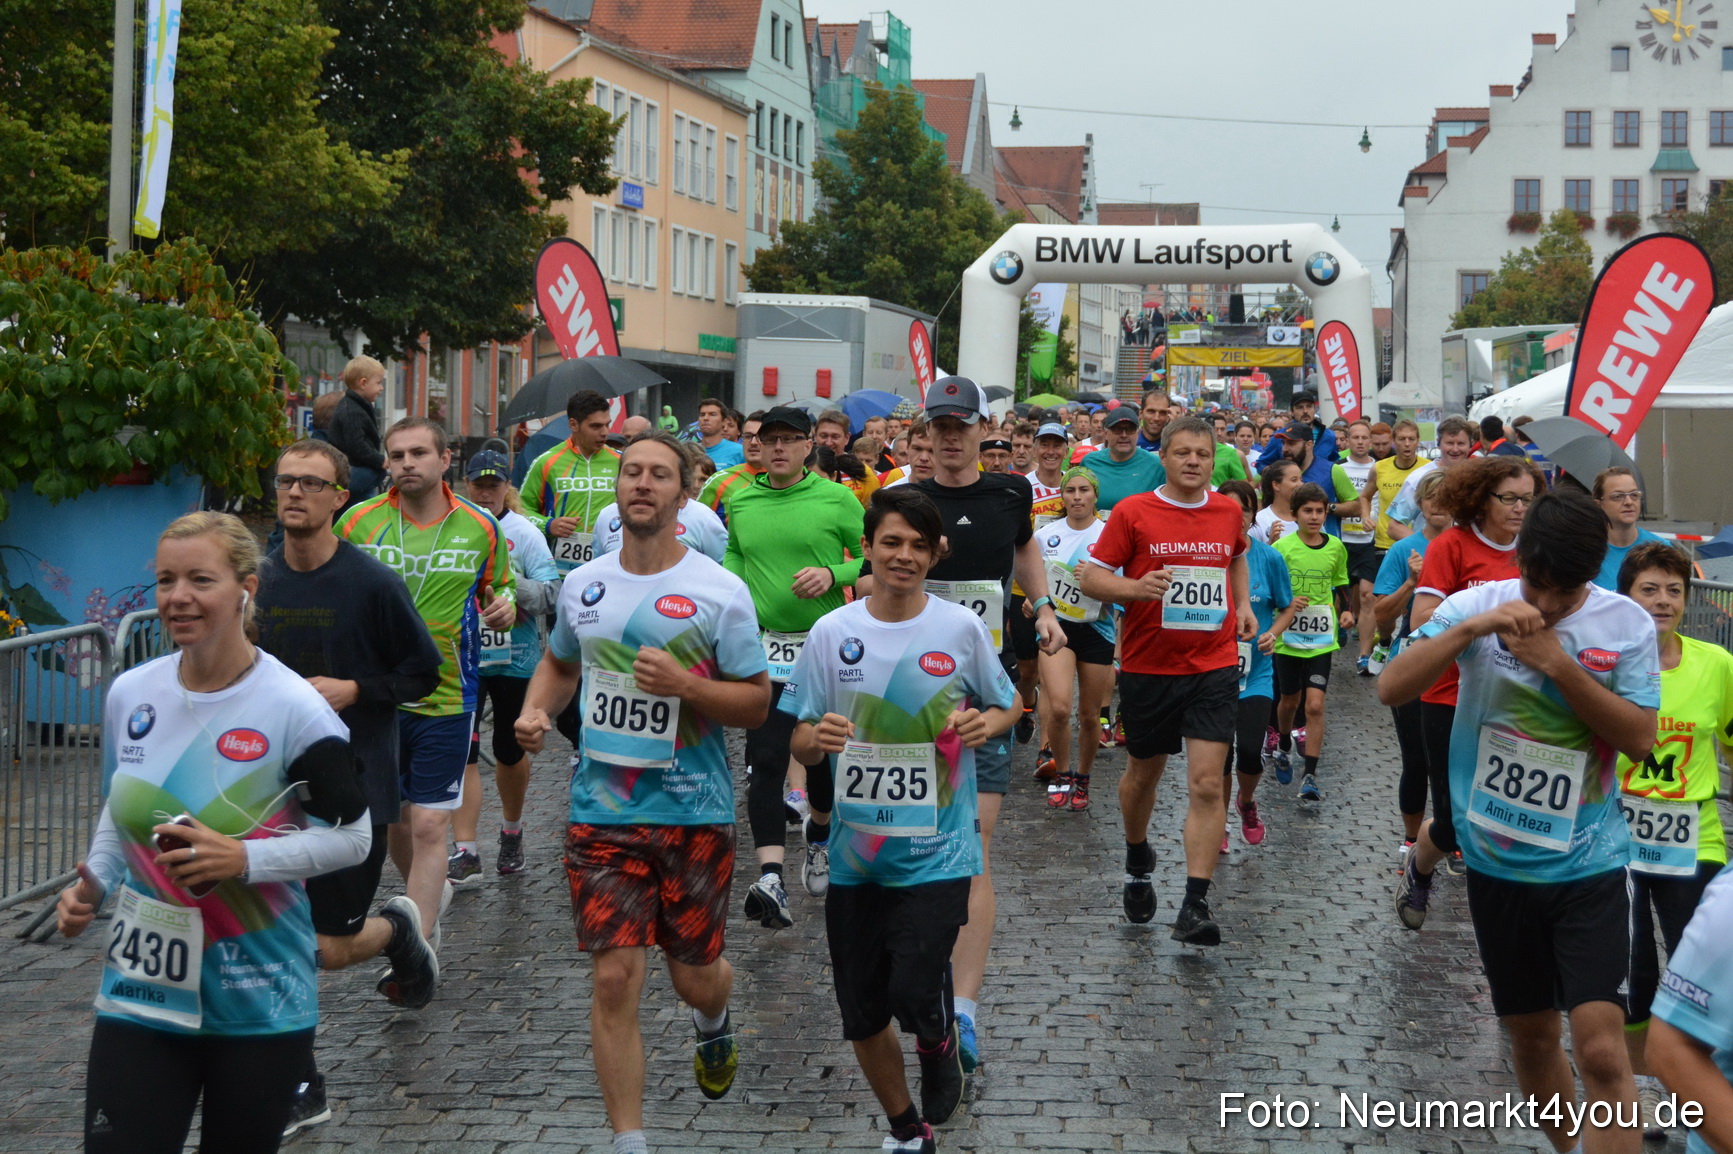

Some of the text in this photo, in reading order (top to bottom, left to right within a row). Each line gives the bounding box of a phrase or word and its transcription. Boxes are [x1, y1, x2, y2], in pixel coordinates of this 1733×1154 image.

[1035, 236, 1293, 270] BMW Laufsport
[1579, 261, 1695, 434] REWE
[1220, 352, 1250, 362] ZIEL
[1149, 542, 1222, 555] NEUMARKT
[956, 584, 996, 593] BOCK
[1170, 581, 1223, 606] 2604
[660, 598, 692, 613] Hervis
[578, 610, 600, 620] PARTL
[1184, 611, 1210, 622] Anton
[1288, 616, 1329, 632] 2643
[924, 656, 952, 670] Hervis
[838, 668, 864, 677] PARTL
[592, 692, 670, 734] 3059
[224, 734, 264, 754] Hervis
[1488, 739, 1518, 755] NeuerMarkt
[845, 752, 874, 760] NeuerMarkt
[880, 747, 928, 758] BOCK
[1524, 744, 1577, 767] BOCK
[1638, 752, 1677, 782] M
[661, 772, 708, 782] Neumarkter
[846, 765, 928, 801] 2735
[1484, 754, 1572, 811] 2820
[662, 782, 702, 792] Stadtlauf
[876, 809, 894, 823] Ali
[1485, 800, 1514, 823] Amir
[1517, 812, 1552, 834] Reza
[910, 841, 951, 856] Stadtlauf
[1638, 846, 1662, 862] Rita
[138, 902, 192, 928] BOCK
[108, 919, 189, 982] 2430
[218, 942, 248, 960] 17.
[221, 976, 276, 990] Stadtlauf
